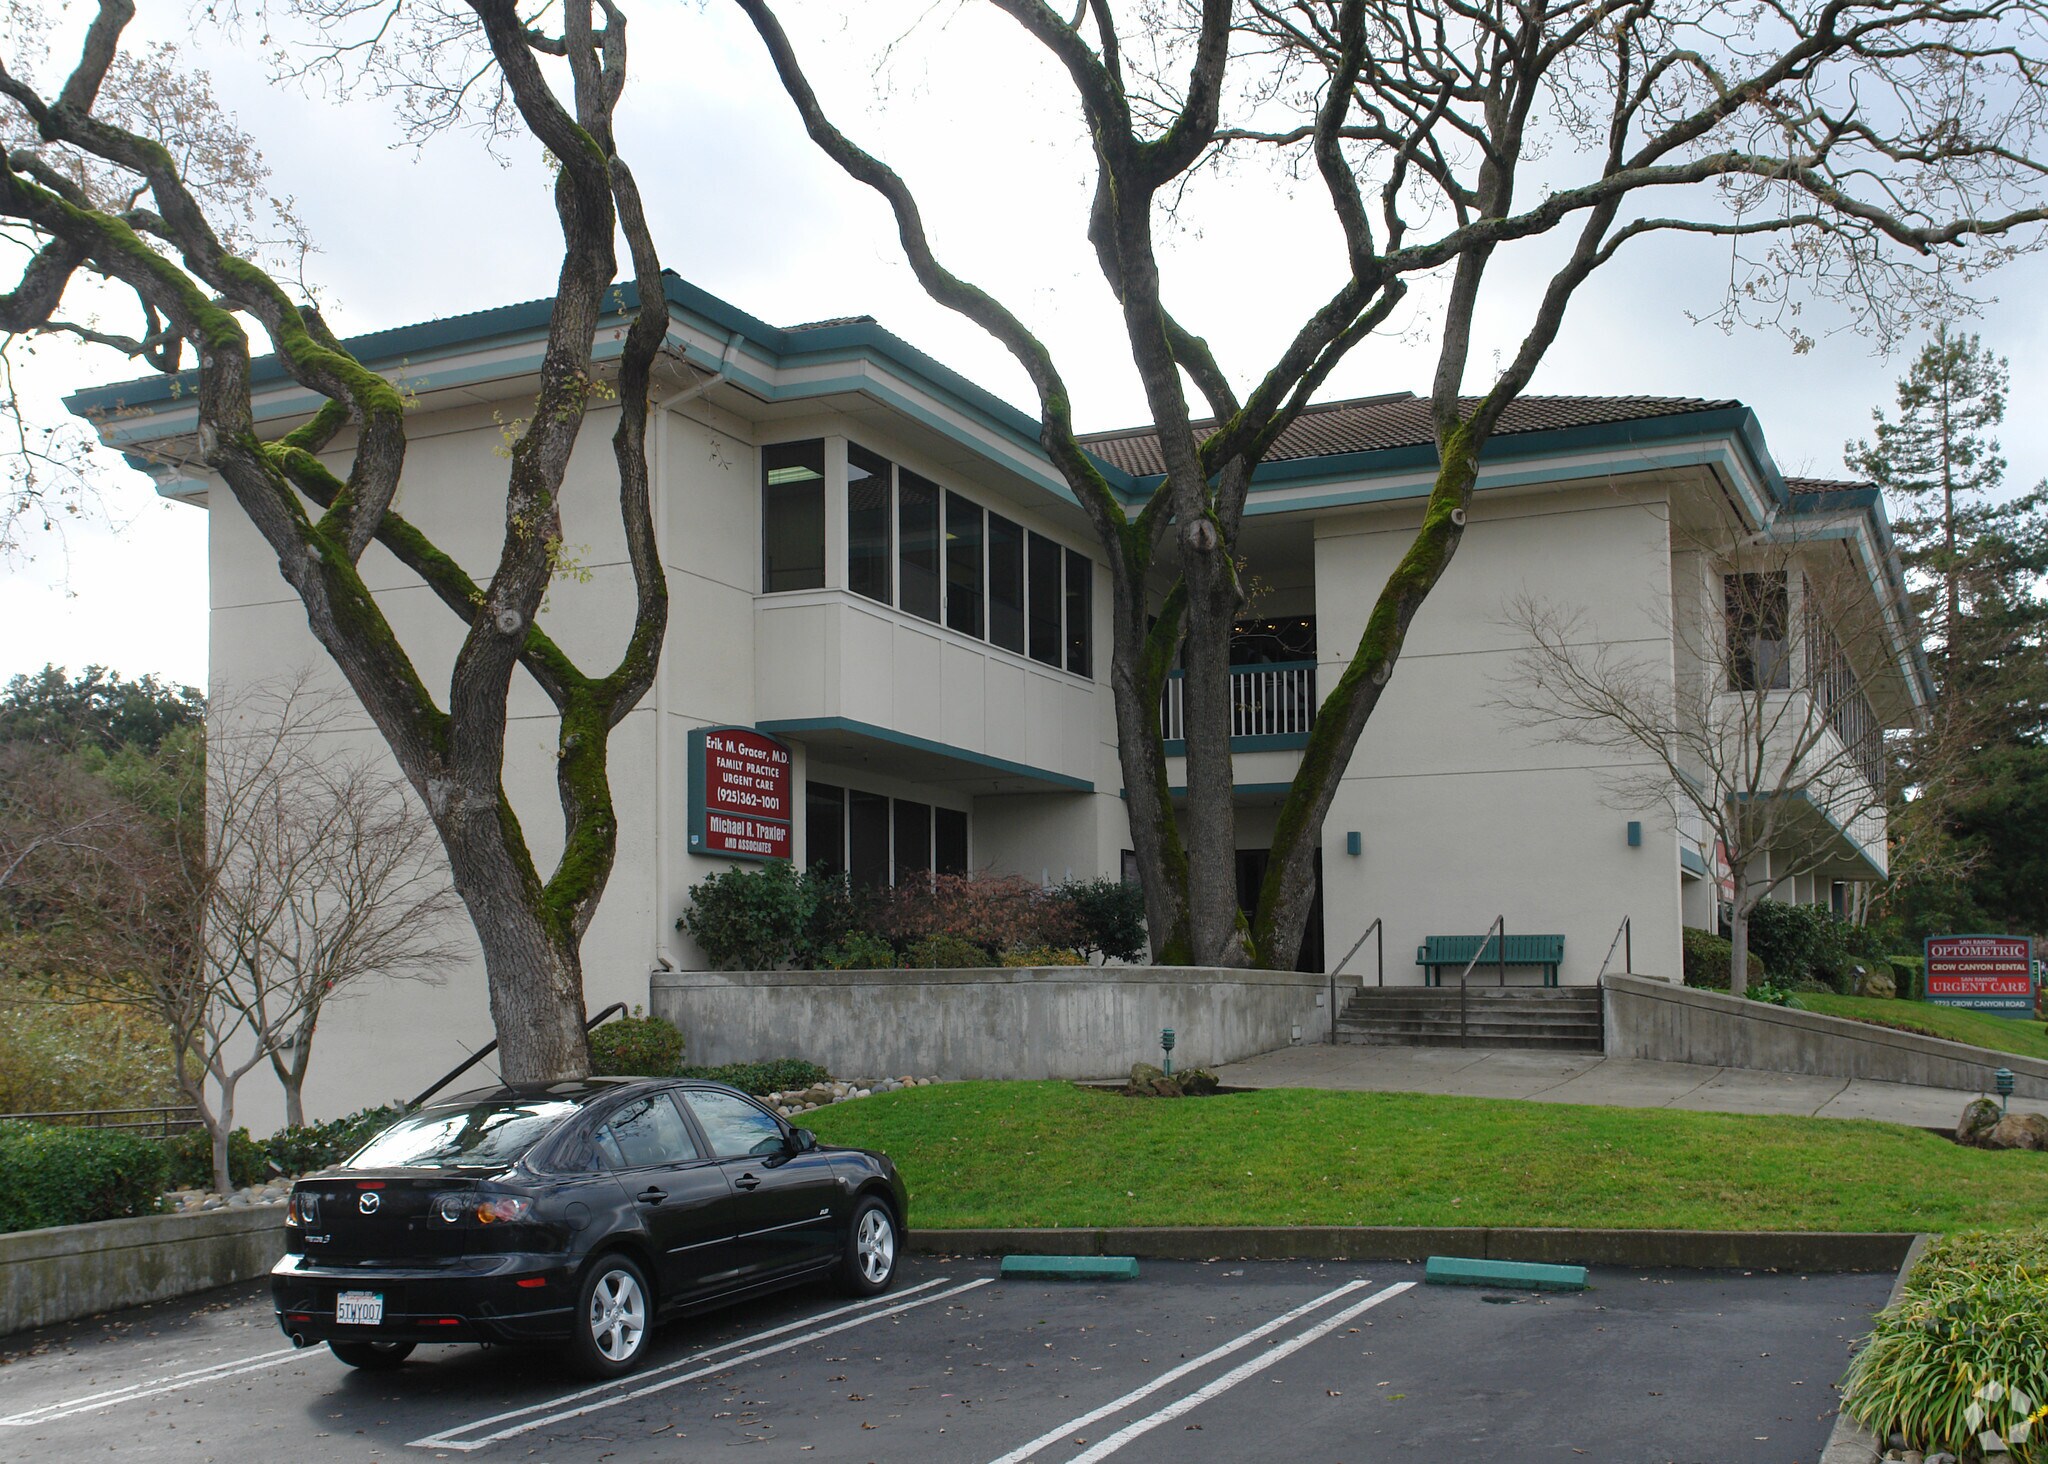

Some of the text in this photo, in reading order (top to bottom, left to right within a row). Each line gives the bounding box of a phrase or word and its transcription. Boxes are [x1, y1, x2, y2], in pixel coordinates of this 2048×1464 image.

[706, 736, 789, 764] Erik M. Gracer, M.D.
[717, 757, 779, 778] FAMILY PRACTICE
[723, 772, 774, 791] URGENT CARE
[717, 787, 779, 810] (925)362-1001
[710, 816, 786, 842] Michael R. Traxler
[725, 837, 772, 854] AND ASSOCIATES
[1931, 945, 2025, 957] OPTOMETRIC
[1933, 982, 2027, 992] URGENT CARE
[1951, 1000, 1973, 1008] CROW
[1974, 1000, 2005, 1008] CANYON
[2005, 1000, 2026, 1008] ROAD
[338, 1302, 381, 1320] 5TWY007
